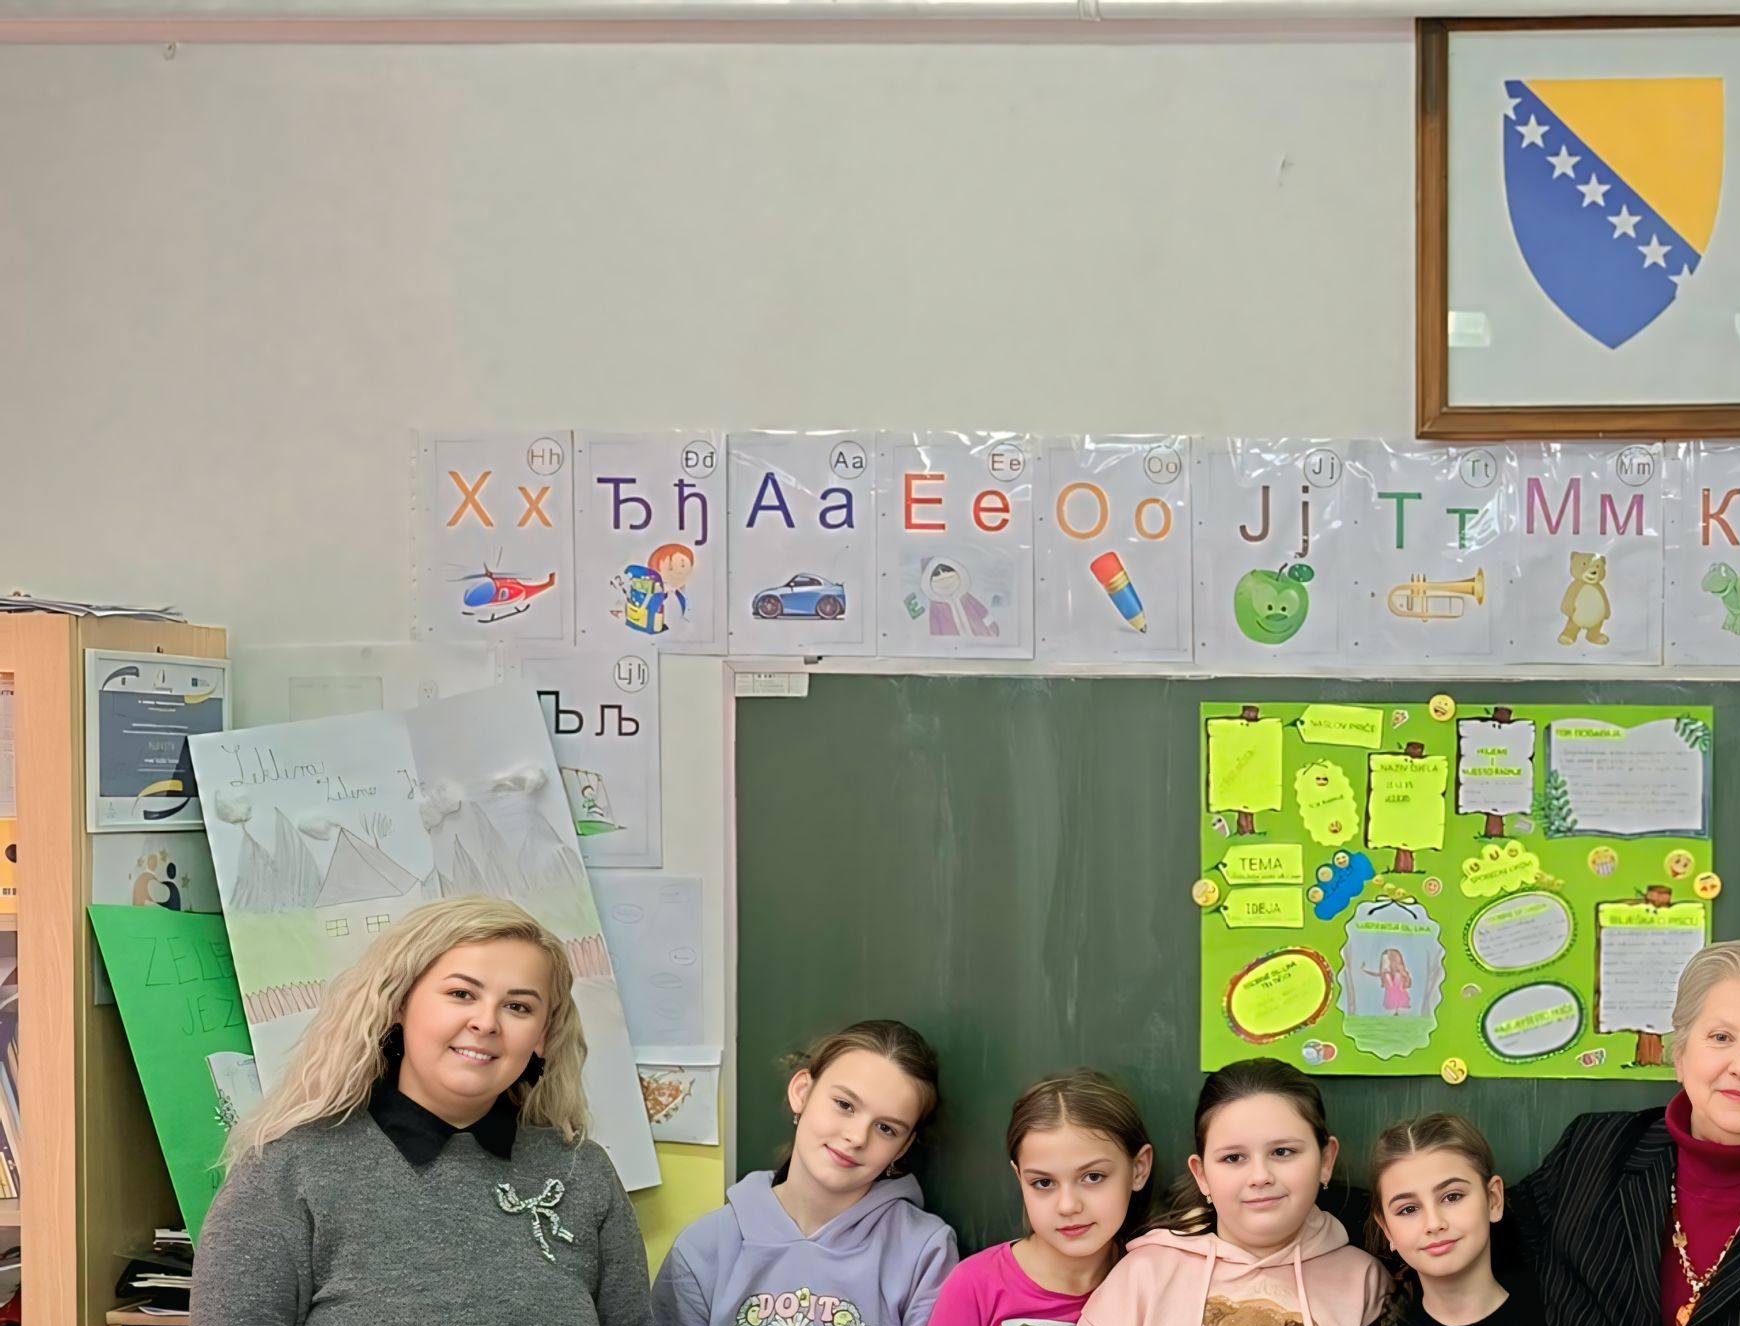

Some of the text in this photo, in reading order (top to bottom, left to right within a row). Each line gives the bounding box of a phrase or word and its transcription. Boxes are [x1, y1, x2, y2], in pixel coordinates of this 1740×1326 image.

[1239, 857, 1284, 872] TEMA
[1246, 902, 1282, 916] IDEJA
[756, 1291, 800, 1320] DO
